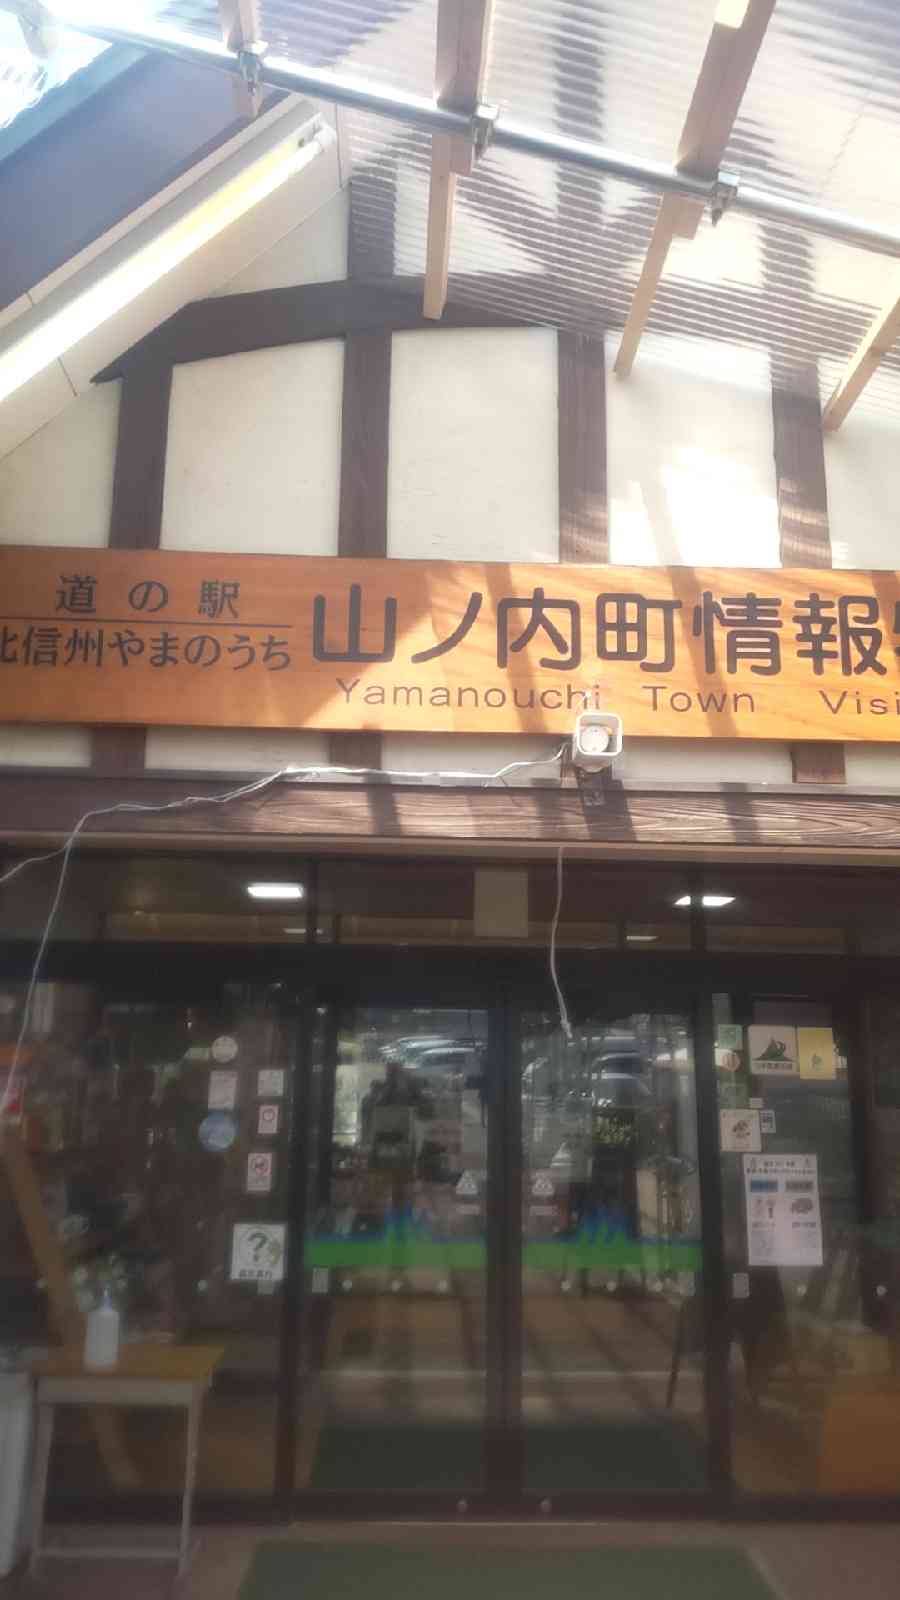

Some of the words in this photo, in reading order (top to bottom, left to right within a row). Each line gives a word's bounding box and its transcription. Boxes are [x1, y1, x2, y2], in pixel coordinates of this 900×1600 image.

[57, 575, 240, 619] 道の駅
[313, 584, 900, 676] 山ノ内町情報
[336, 677, 601, 710] Yamanouchi
[642, 686, 754, 713] Town
[819, 690, 900, 715] Visi
